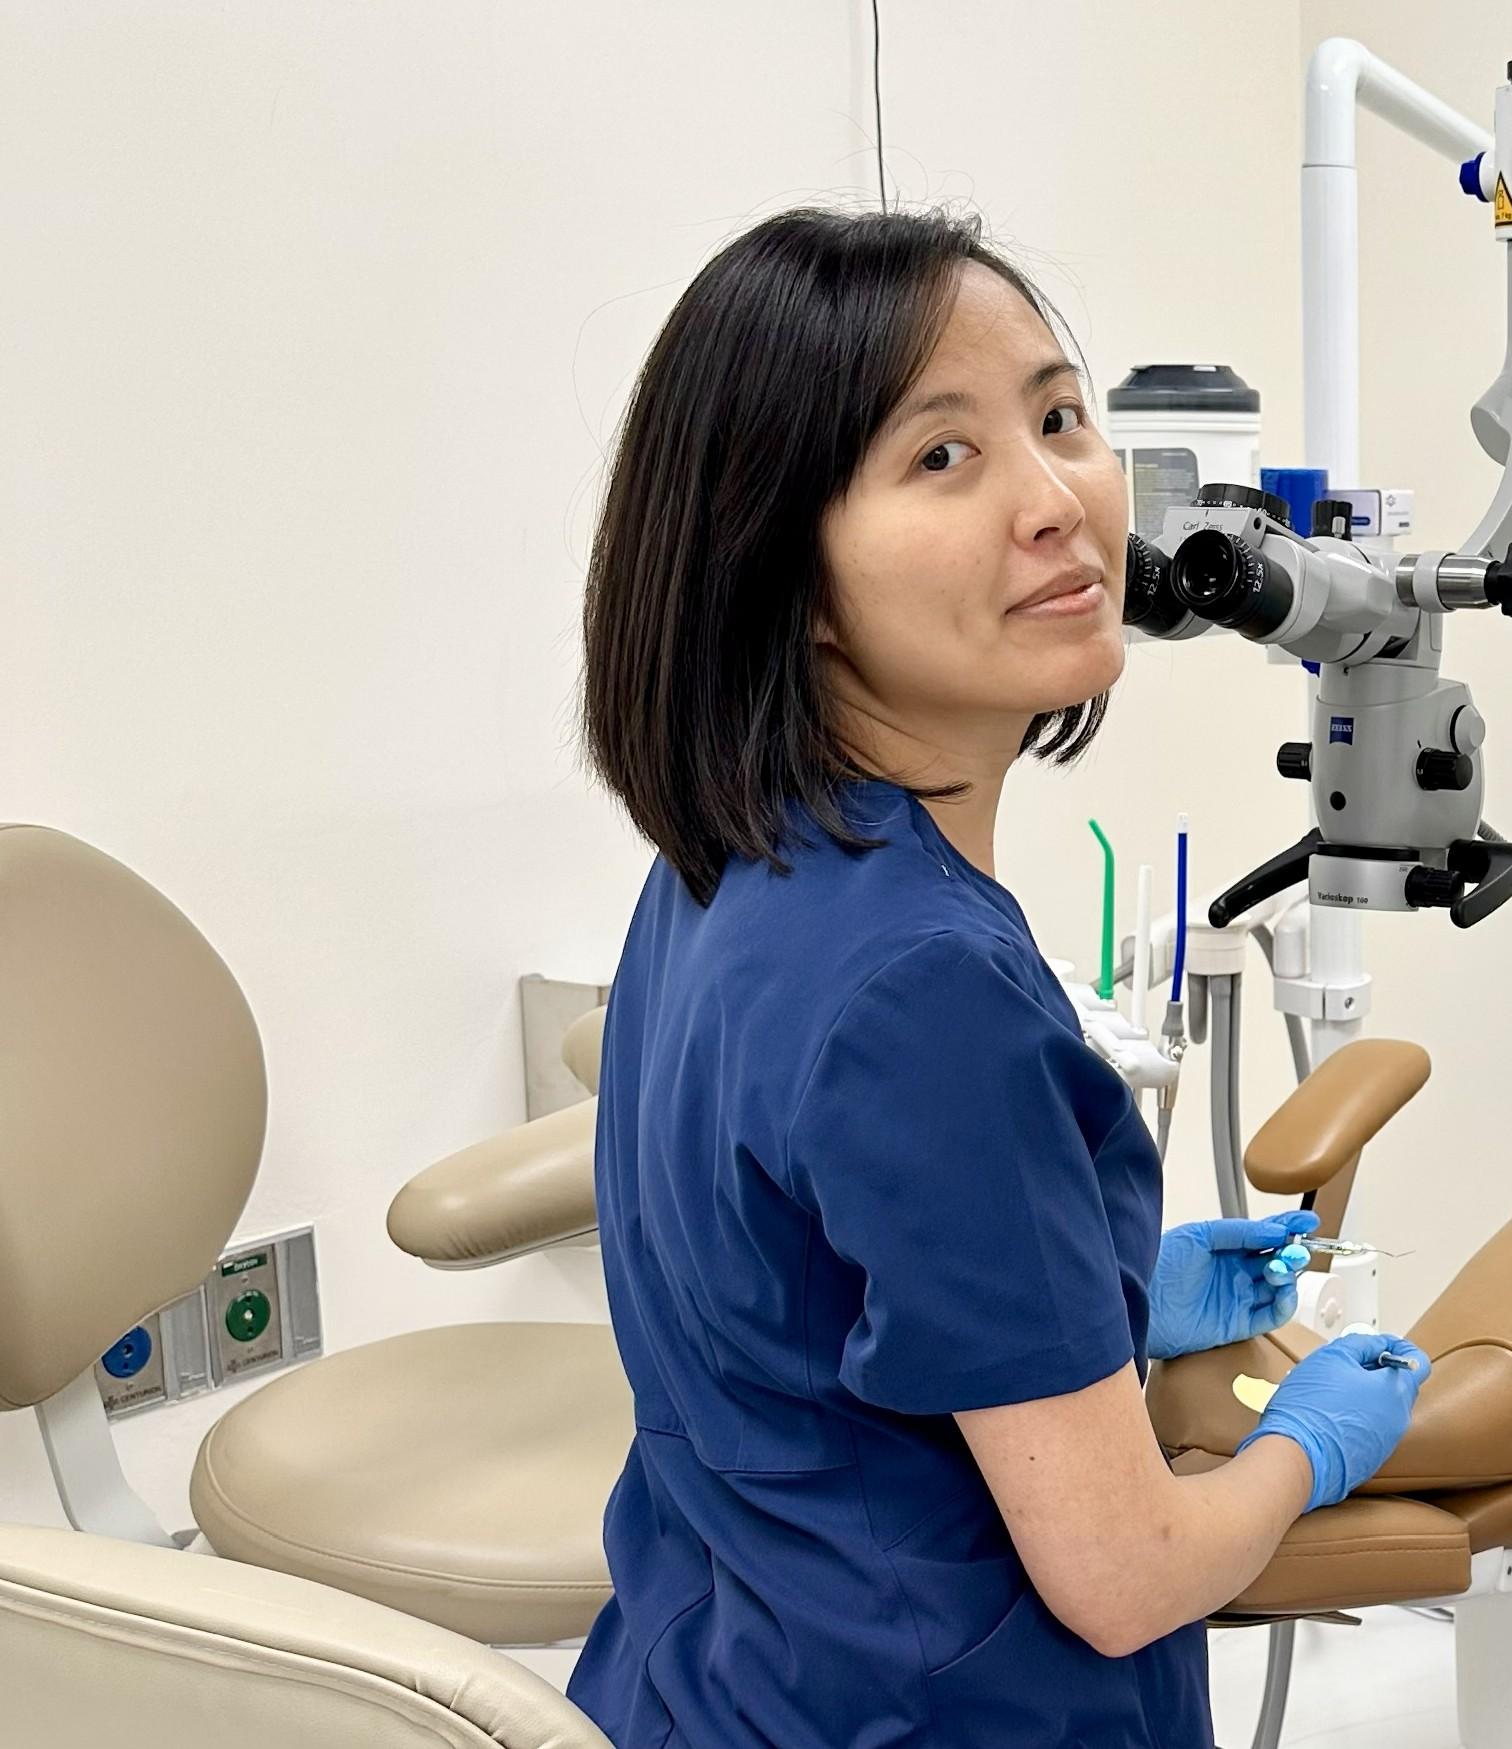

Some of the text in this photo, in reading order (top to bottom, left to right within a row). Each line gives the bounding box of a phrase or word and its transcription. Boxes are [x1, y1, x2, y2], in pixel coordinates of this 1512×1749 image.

[1183, 521, 1200, 531] Carl
[1331, 724, 1353, 733] ZEISS
[1317, 891, 1354, 905] Varioskop
